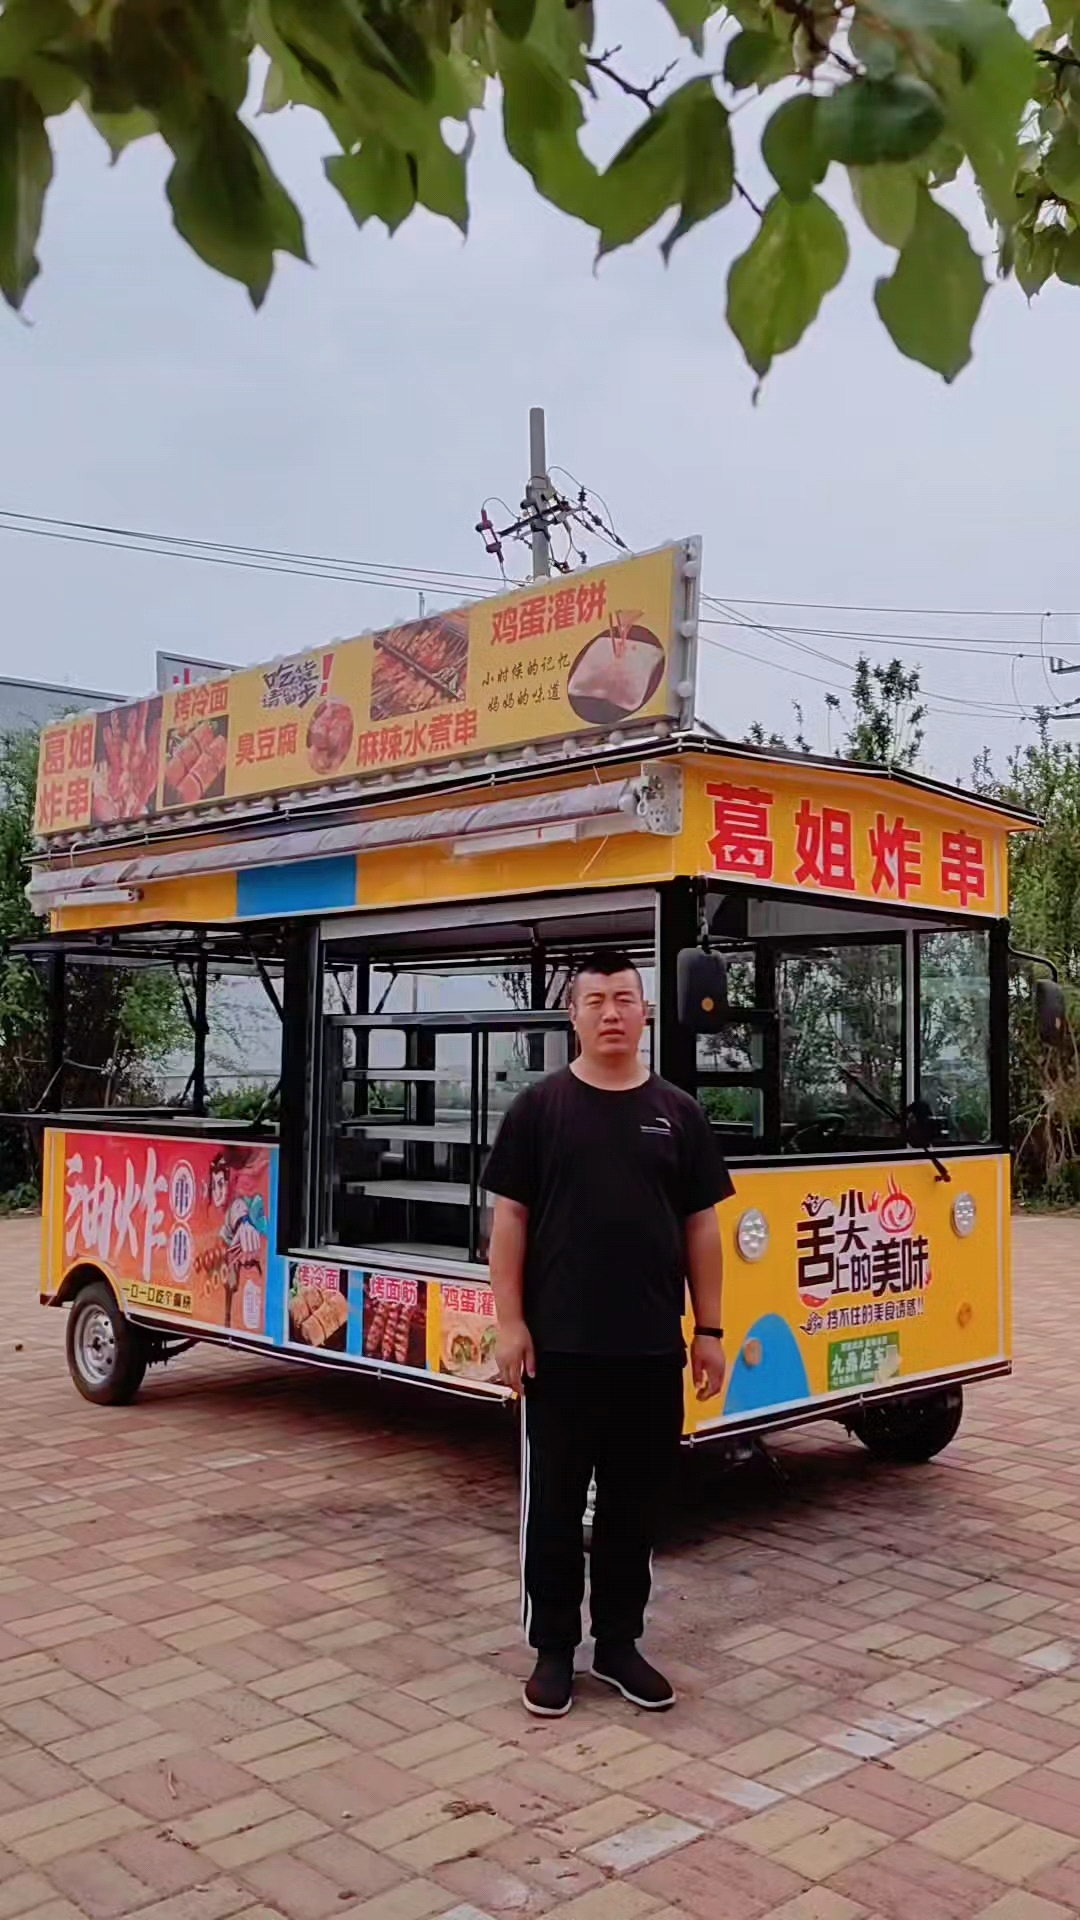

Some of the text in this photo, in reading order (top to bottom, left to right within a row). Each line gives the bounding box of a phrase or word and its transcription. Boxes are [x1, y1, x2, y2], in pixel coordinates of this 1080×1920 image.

[490, 578, 607, 647] 鸡蛋灌饼
[482, 652, 571, 687] 小时候的记忆
[174, 680, 229, 724] 烤冷面
[487, 680, 561, 712] 妈妈的味道
[235, 723, 298, 767] 臭豆腐
[355, 708, 479, 767] 麻辣水煮串
[39, 777, 89, 827] 炸串
[704, 781, 987, 908] 葛姐炸串
[65, 1147, 168, 1282] 油炸
[796, 1188, 930, 1298] 舌尖上的美味
[298, 1262, 340, 1292] 烤冷面
[368, 1273, 418, 1307] 烤面筋
